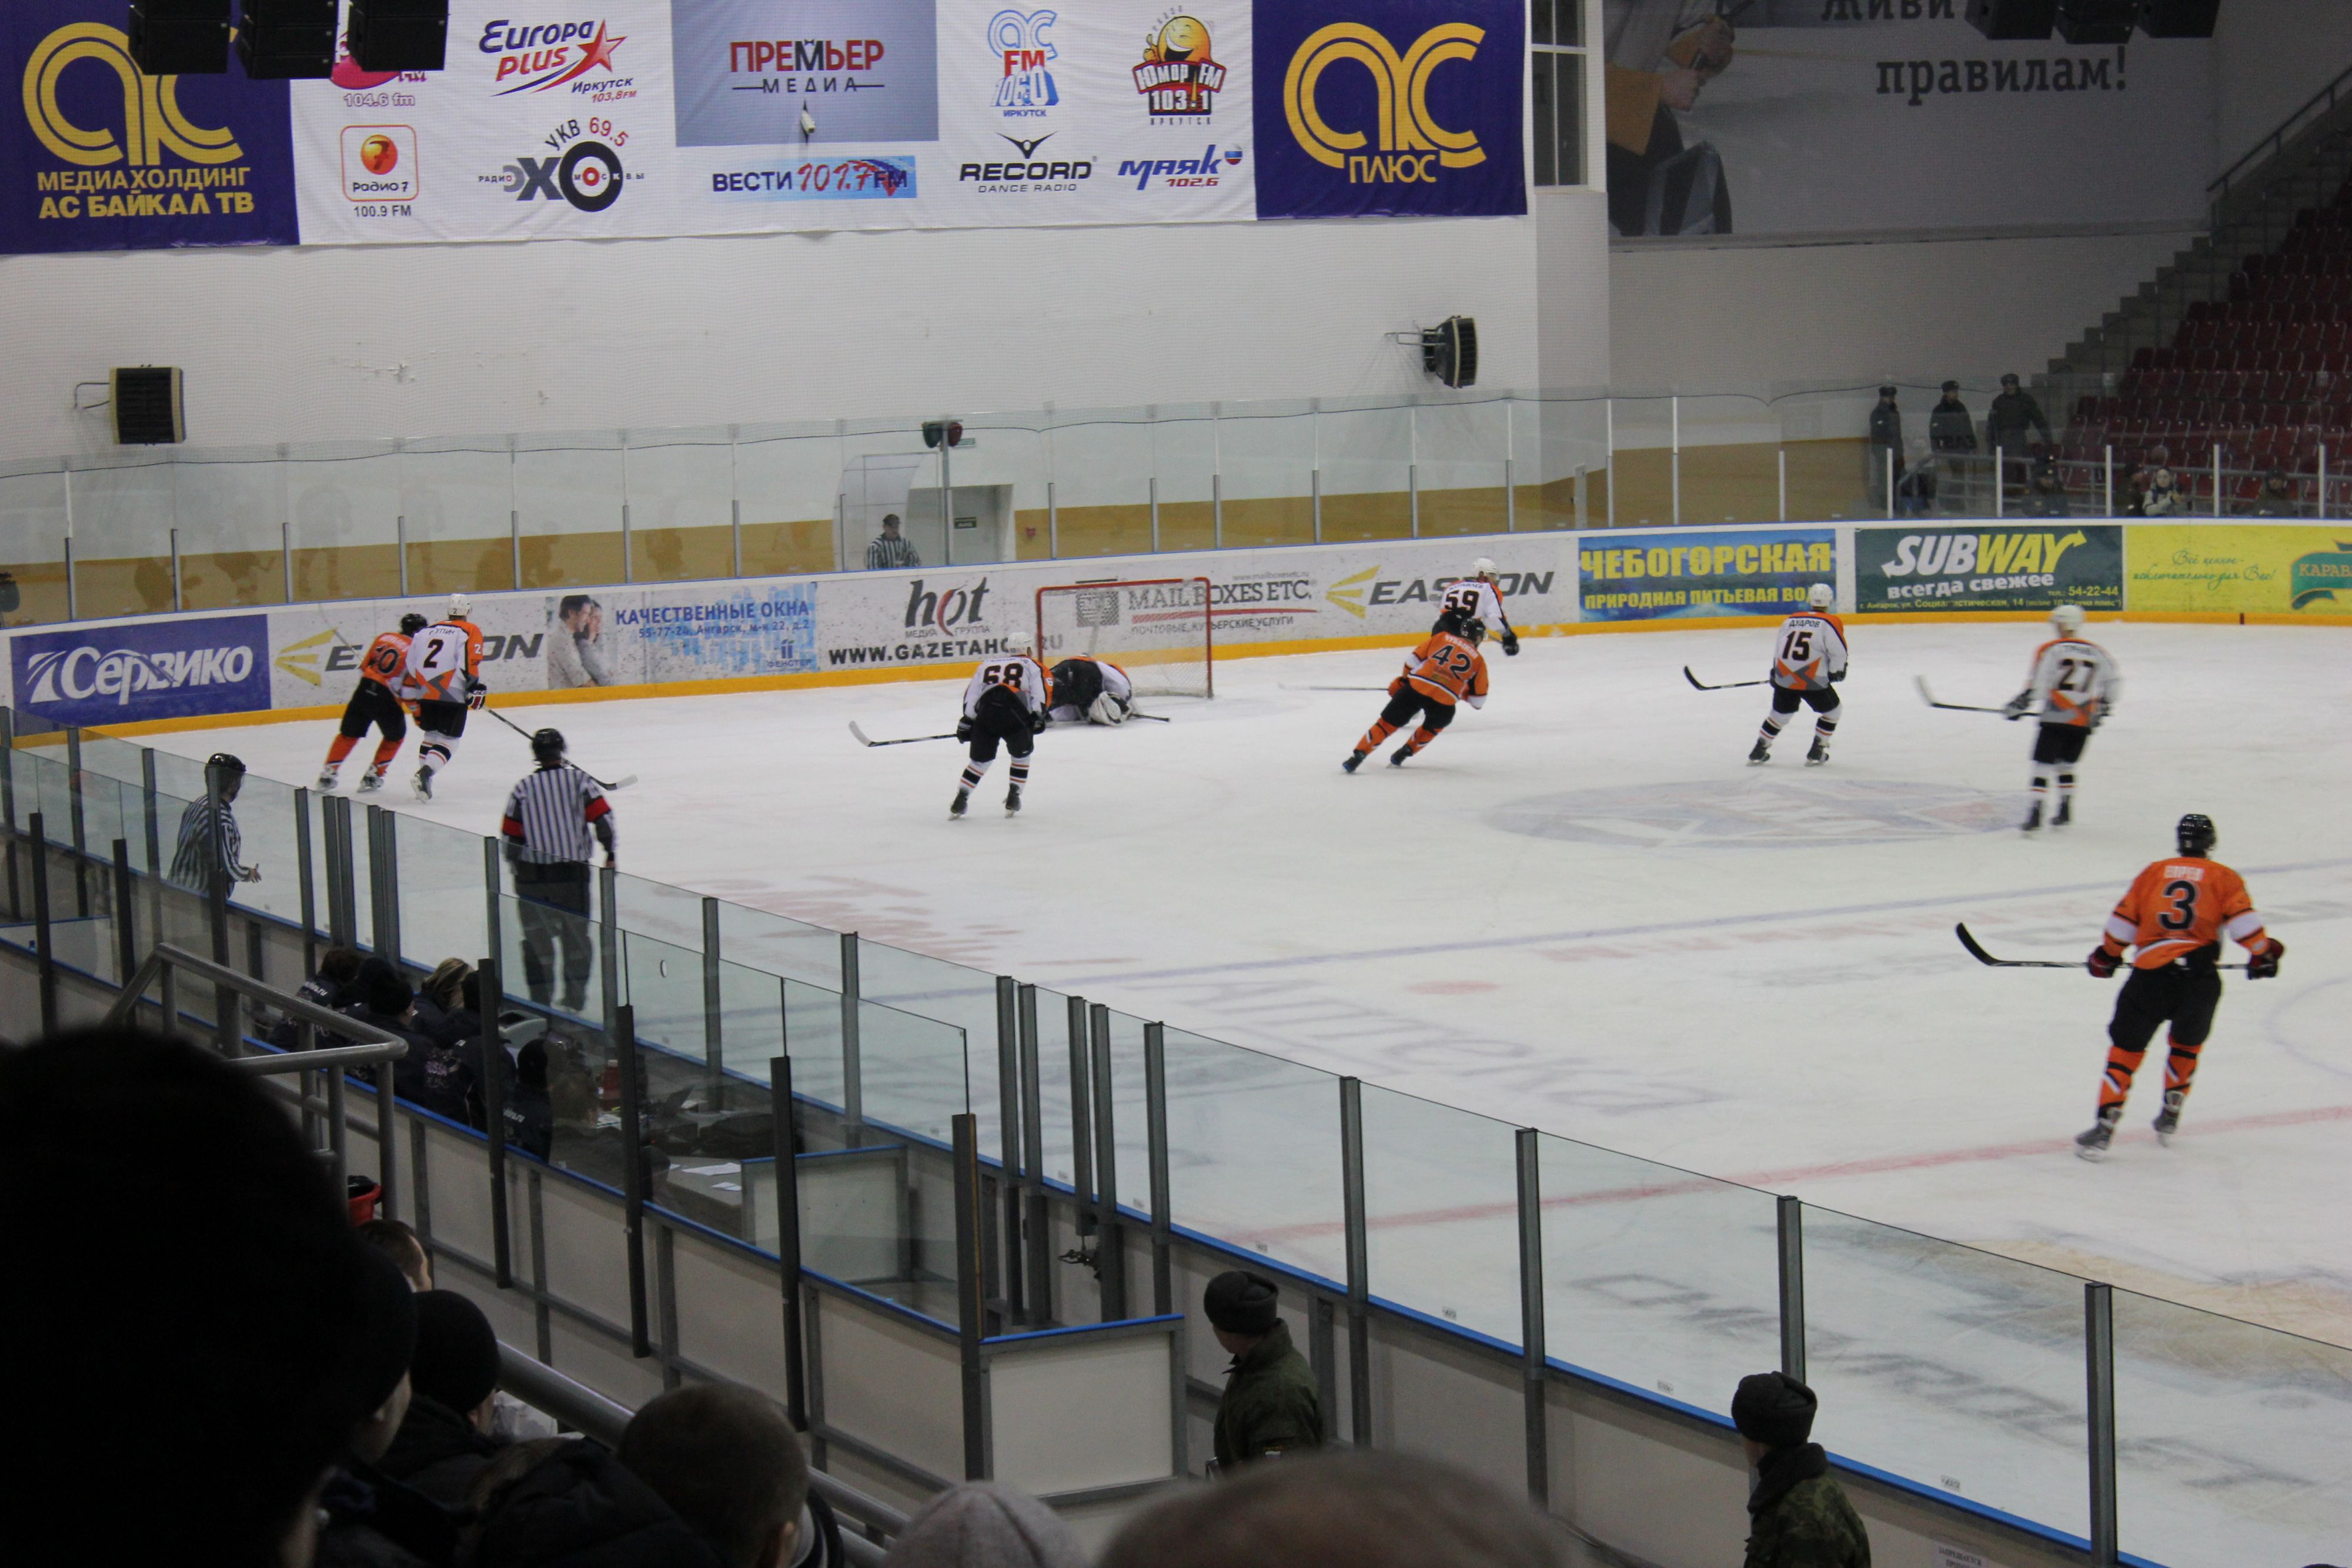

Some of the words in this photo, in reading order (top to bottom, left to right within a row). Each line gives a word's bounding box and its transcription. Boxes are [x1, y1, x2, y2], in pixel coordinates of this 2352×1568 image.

[479, 19, 594, 54] Europa
[729, 39, 884, 73] ПРЕМЬЕР
[1004, 50, 1045, 78] FM
[571, 77, 633, 94] Иркутск
[763, 76, 857, 94] МЕДИА
[1198, 62, 1224, 89] FM
[1875, 45, 2127, 106] правилам!
[343, 93, 389, 107] 104.6
[392, 93, 415, 106] fm
[1151, 89, 1210, 111] 103.1
[1003, 109, 1047, 118] ИРКУТСК
[545, 119, 581, 151] УКВ
[589, 117, 629, 147] 69.5
[37, 167, 251, 193] МЕДИАХОЛДИНГ
[960, 162, 1092, 181] RECORD
[1349, 154, 1439, 183] ПЛЮС
[401, 181, 409, 192] 7
[713, 171, 793, 192] ВЕСТИ
[978, 185, 1028, 193] DANCE
[1033, 183, 1077, 192] RADIO
[39, 196, 80, 219] АС
[88, 189, 211, 218] БАЙКАЛ
[215, 192, 255, 214] ТВ
[354, 206, 387, 217] 100.9
[392, 205, 411, 216] FM
[1581, 543, 1831, 579] ЧЕБОГОРСКАЯ
[1882, 530, 2087, 578] SUBWAY
[1128, 587, 1190, 610] MAIL
[1192, 582, 1264, 606] BOXES
[1585, 590, 1686, 610] ПРИРОДНАЯ
[1690, 587, 1778, 606] ПИТЬЕВАЯ
[1887, 580, 1964, 599] всегда
[1970, 573, 2055, 593] свежее
[2068, 586, 2119, 597] 54-22-44
[616, 603, 756, 625] КАЧЕСТВЕННЫЕ
[761, 601, 810, 617] ОКНА
[905, 577, 990, 637] hot
[1445, 590, 1479, 616] 59
[2013, 598, 2024, 606] 14
[905, 628, 938, 638] МЕДИА
[954, 624, 991, 636] ГРУППА
[1192, 618, 1255, 633] КУЬЕРСКИЕ
[1256, 616, 1294, 628] УСЛУГИ
[423, 638, 444, 668] 2
[475, 644, 481, 654] 2
[1782, 631, 1813, 661] 15
[767, 658, 811, 668] ФЕНСТЕР
[1431, 644, 1472, 680] 42
[983, 663, 1024, 688] 68
[2159, 880, 2201, 931] 3
